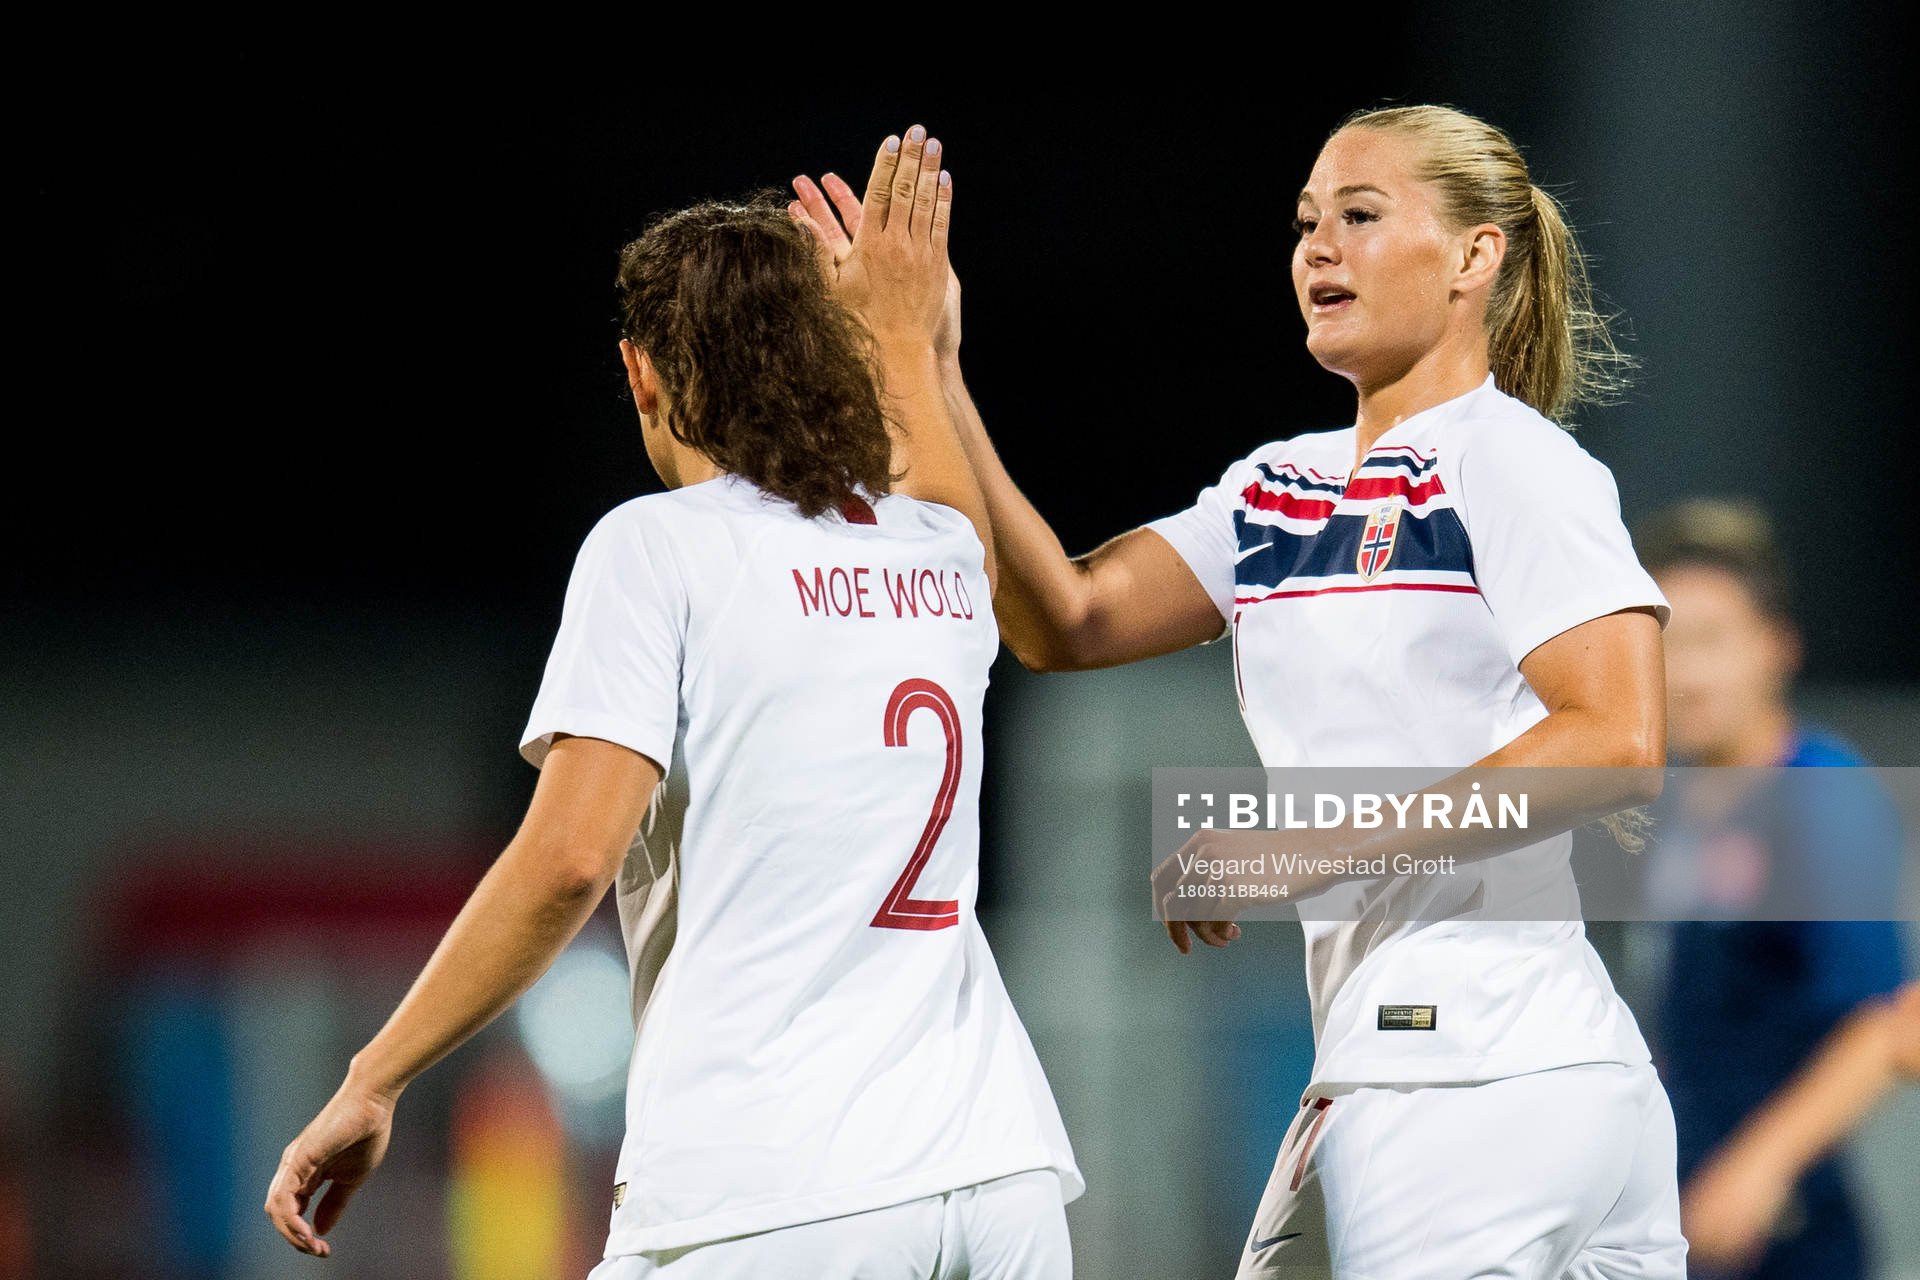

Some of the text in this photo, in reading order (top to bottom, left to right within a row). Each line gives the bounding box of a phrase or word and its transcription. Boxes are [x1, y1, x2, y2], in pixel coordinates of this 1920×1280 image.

[792, 567, 973, 620] MOE WOLD
[869, 677, 963, 932] 2
